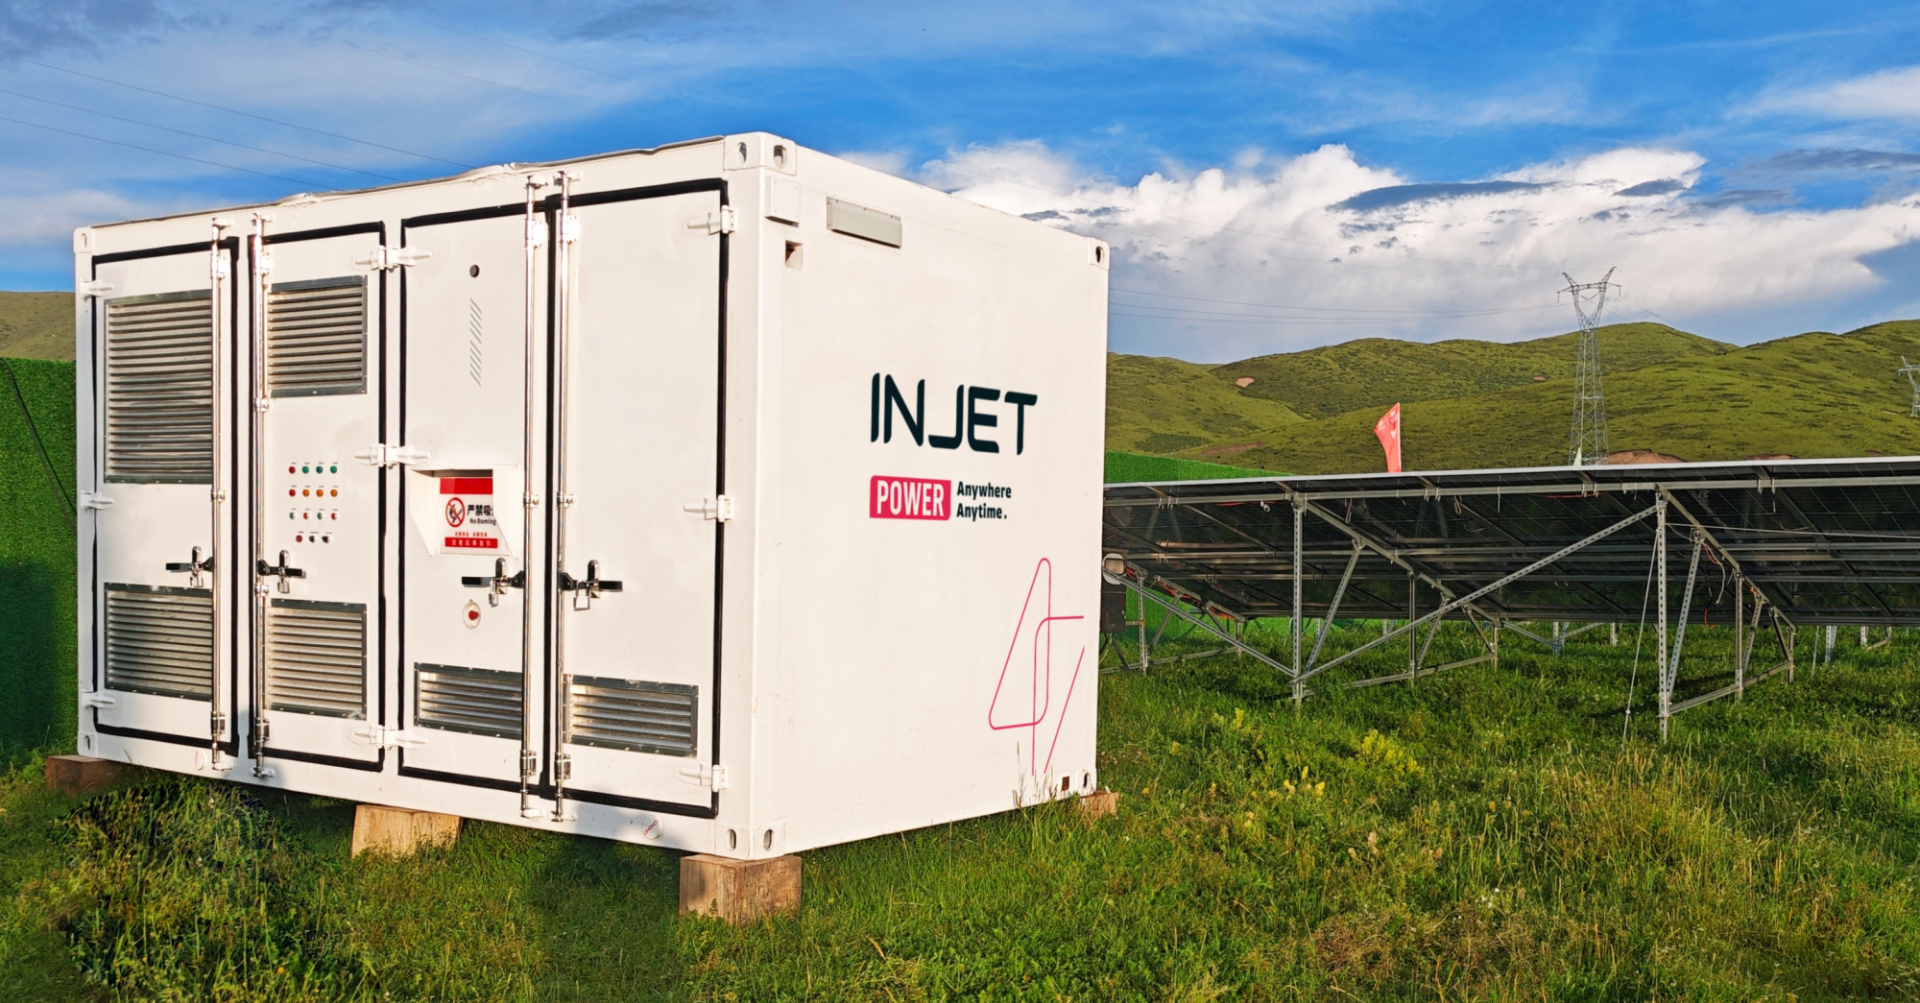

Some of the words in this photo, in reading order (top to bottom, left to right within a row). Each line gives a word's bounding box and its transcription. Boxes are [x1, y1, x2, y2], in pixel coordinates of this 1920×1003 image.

[870, 372, 1038, 456] INJET
[876, 480, 945, 517] POWER
[956, 481, 1012, 500] Anywhere
[467, 504, 494, 516] 严禁吸
[956, 503, 1008, 522] Anytime.
